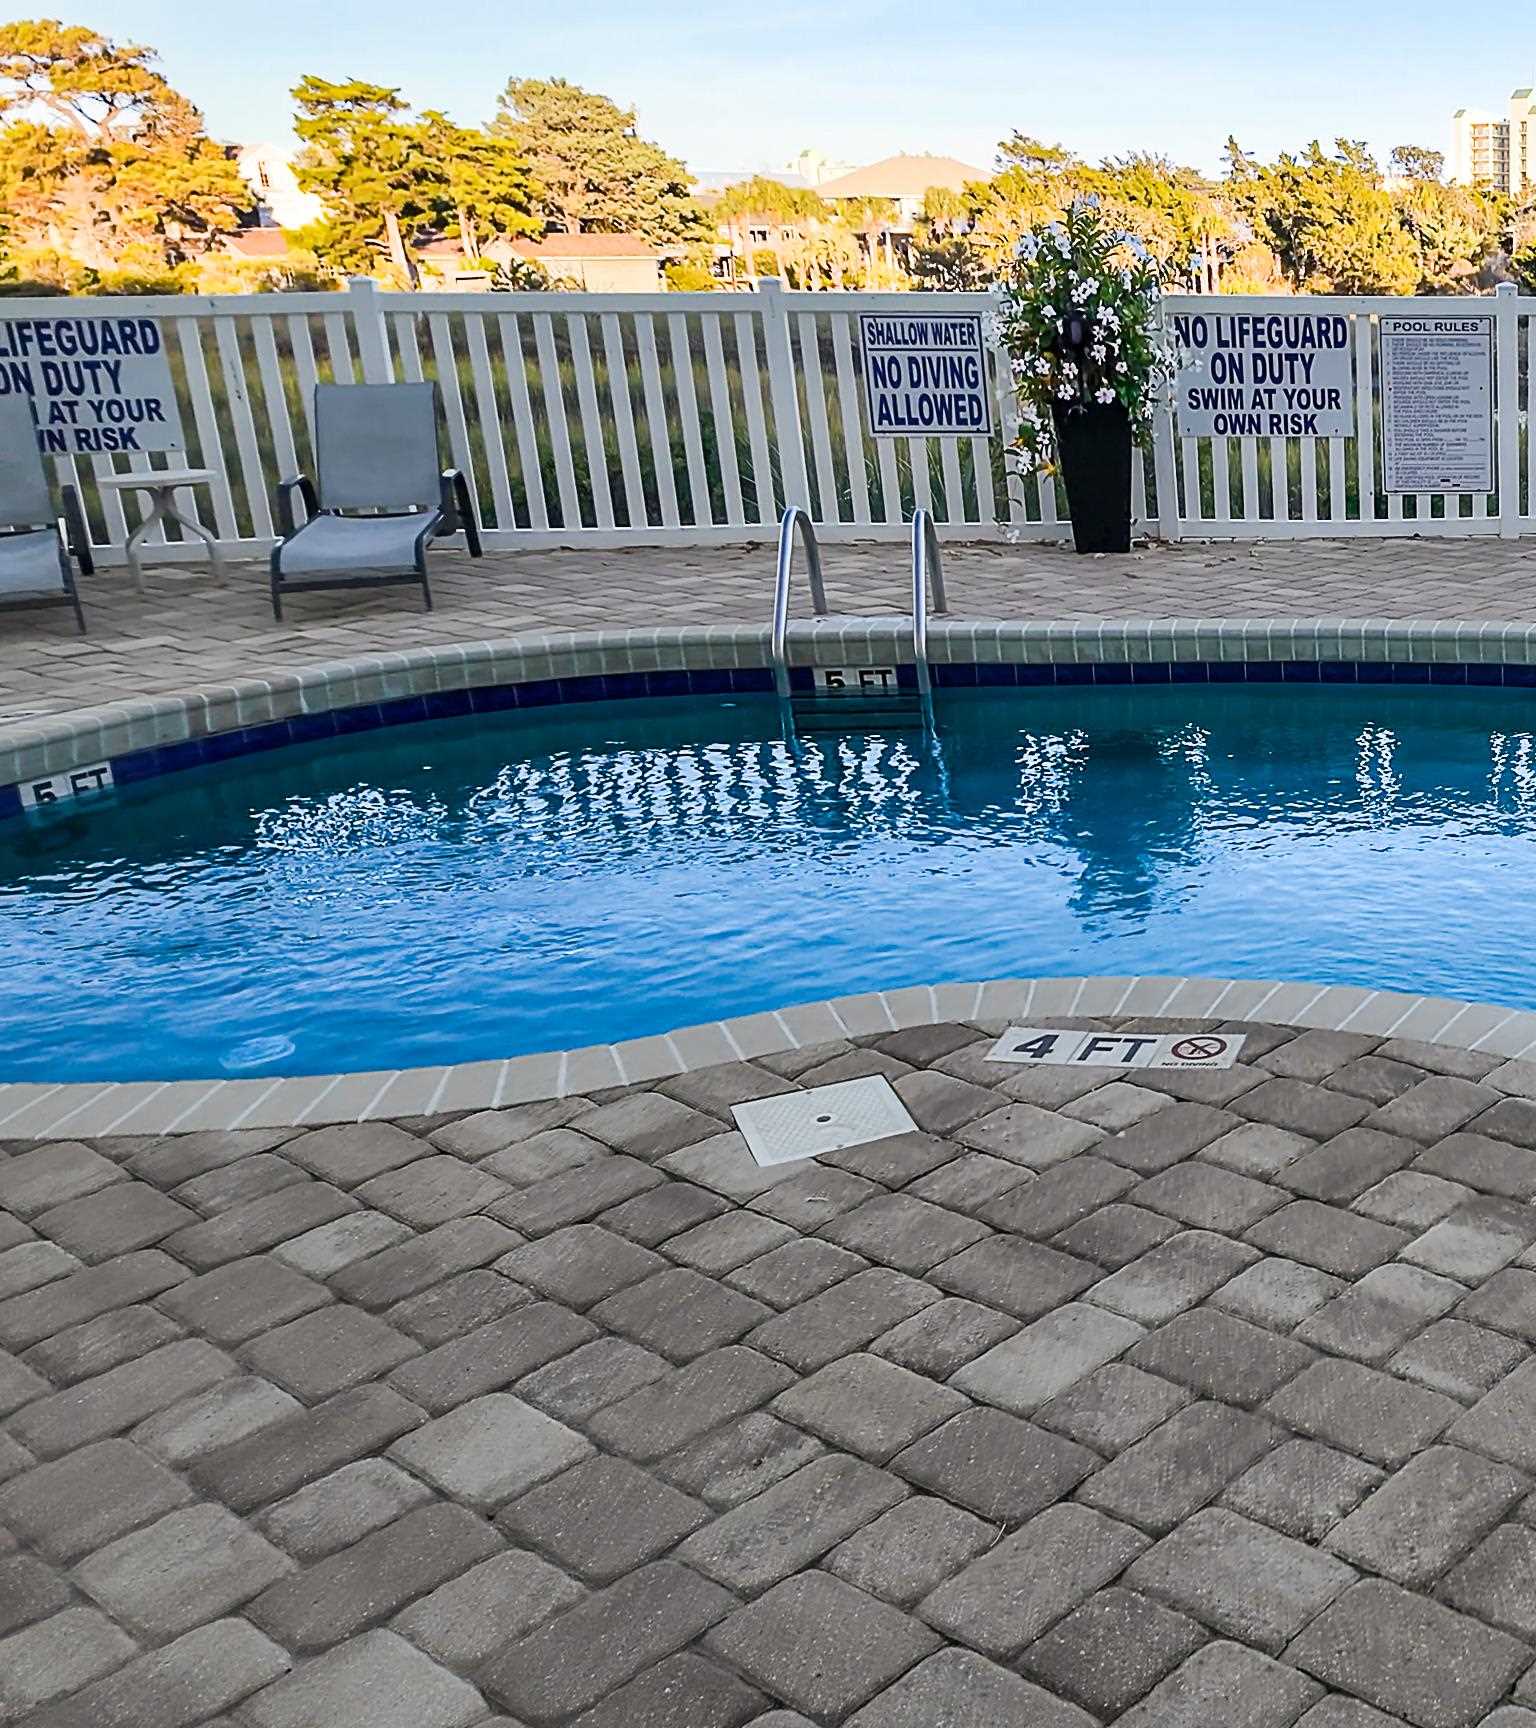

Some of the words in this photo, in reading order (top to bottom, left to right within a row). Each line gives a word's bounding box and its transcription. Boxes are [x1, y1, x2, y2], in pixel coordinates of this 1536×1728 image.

[0, 320, 160, 357] IFEGUARD
[867, 322, 928, 346] SHALLOW
[931, 322, 977, 346] WATER
[1174, 316, 1208, 349] NO
[1216, 316, 1347, 349] LIFEGUARD
[1393, 322, 1430, 332] POOL
[1434, 322, 1479, 332] RULES
[40, 360, 122, 396] DUTY
[871, 356, 902, 389] NO
[907, 356, 980, 389] DIVING
[1211, 352, 1245, 385] ON
[1252, 353, 1315, 385] DUTY
[49, 400, 79, 425] AT
[87, 398, 166, 424] YOUR
[878, 393, 983, 426] ALLOWED
[1188, 388, 1244, 410] SWIM
[1251, 388, 1276, 410] AT
[1283, 388, 1341, 410] YOUR
[1214, 413, 1262, 435] OWN
[1269, 413, 1318, 435] RISK
[73, 426, 141, 452] RISK
[824, 670, 847, 689] 5
[858, 669, 892, 689] FT
[32, 781, 58, 804] 5
[70, 767, 107, 794] FT
[1012, 1034, 1060, 1059] 4
[1076, 1037, 1158, 1063] FT
